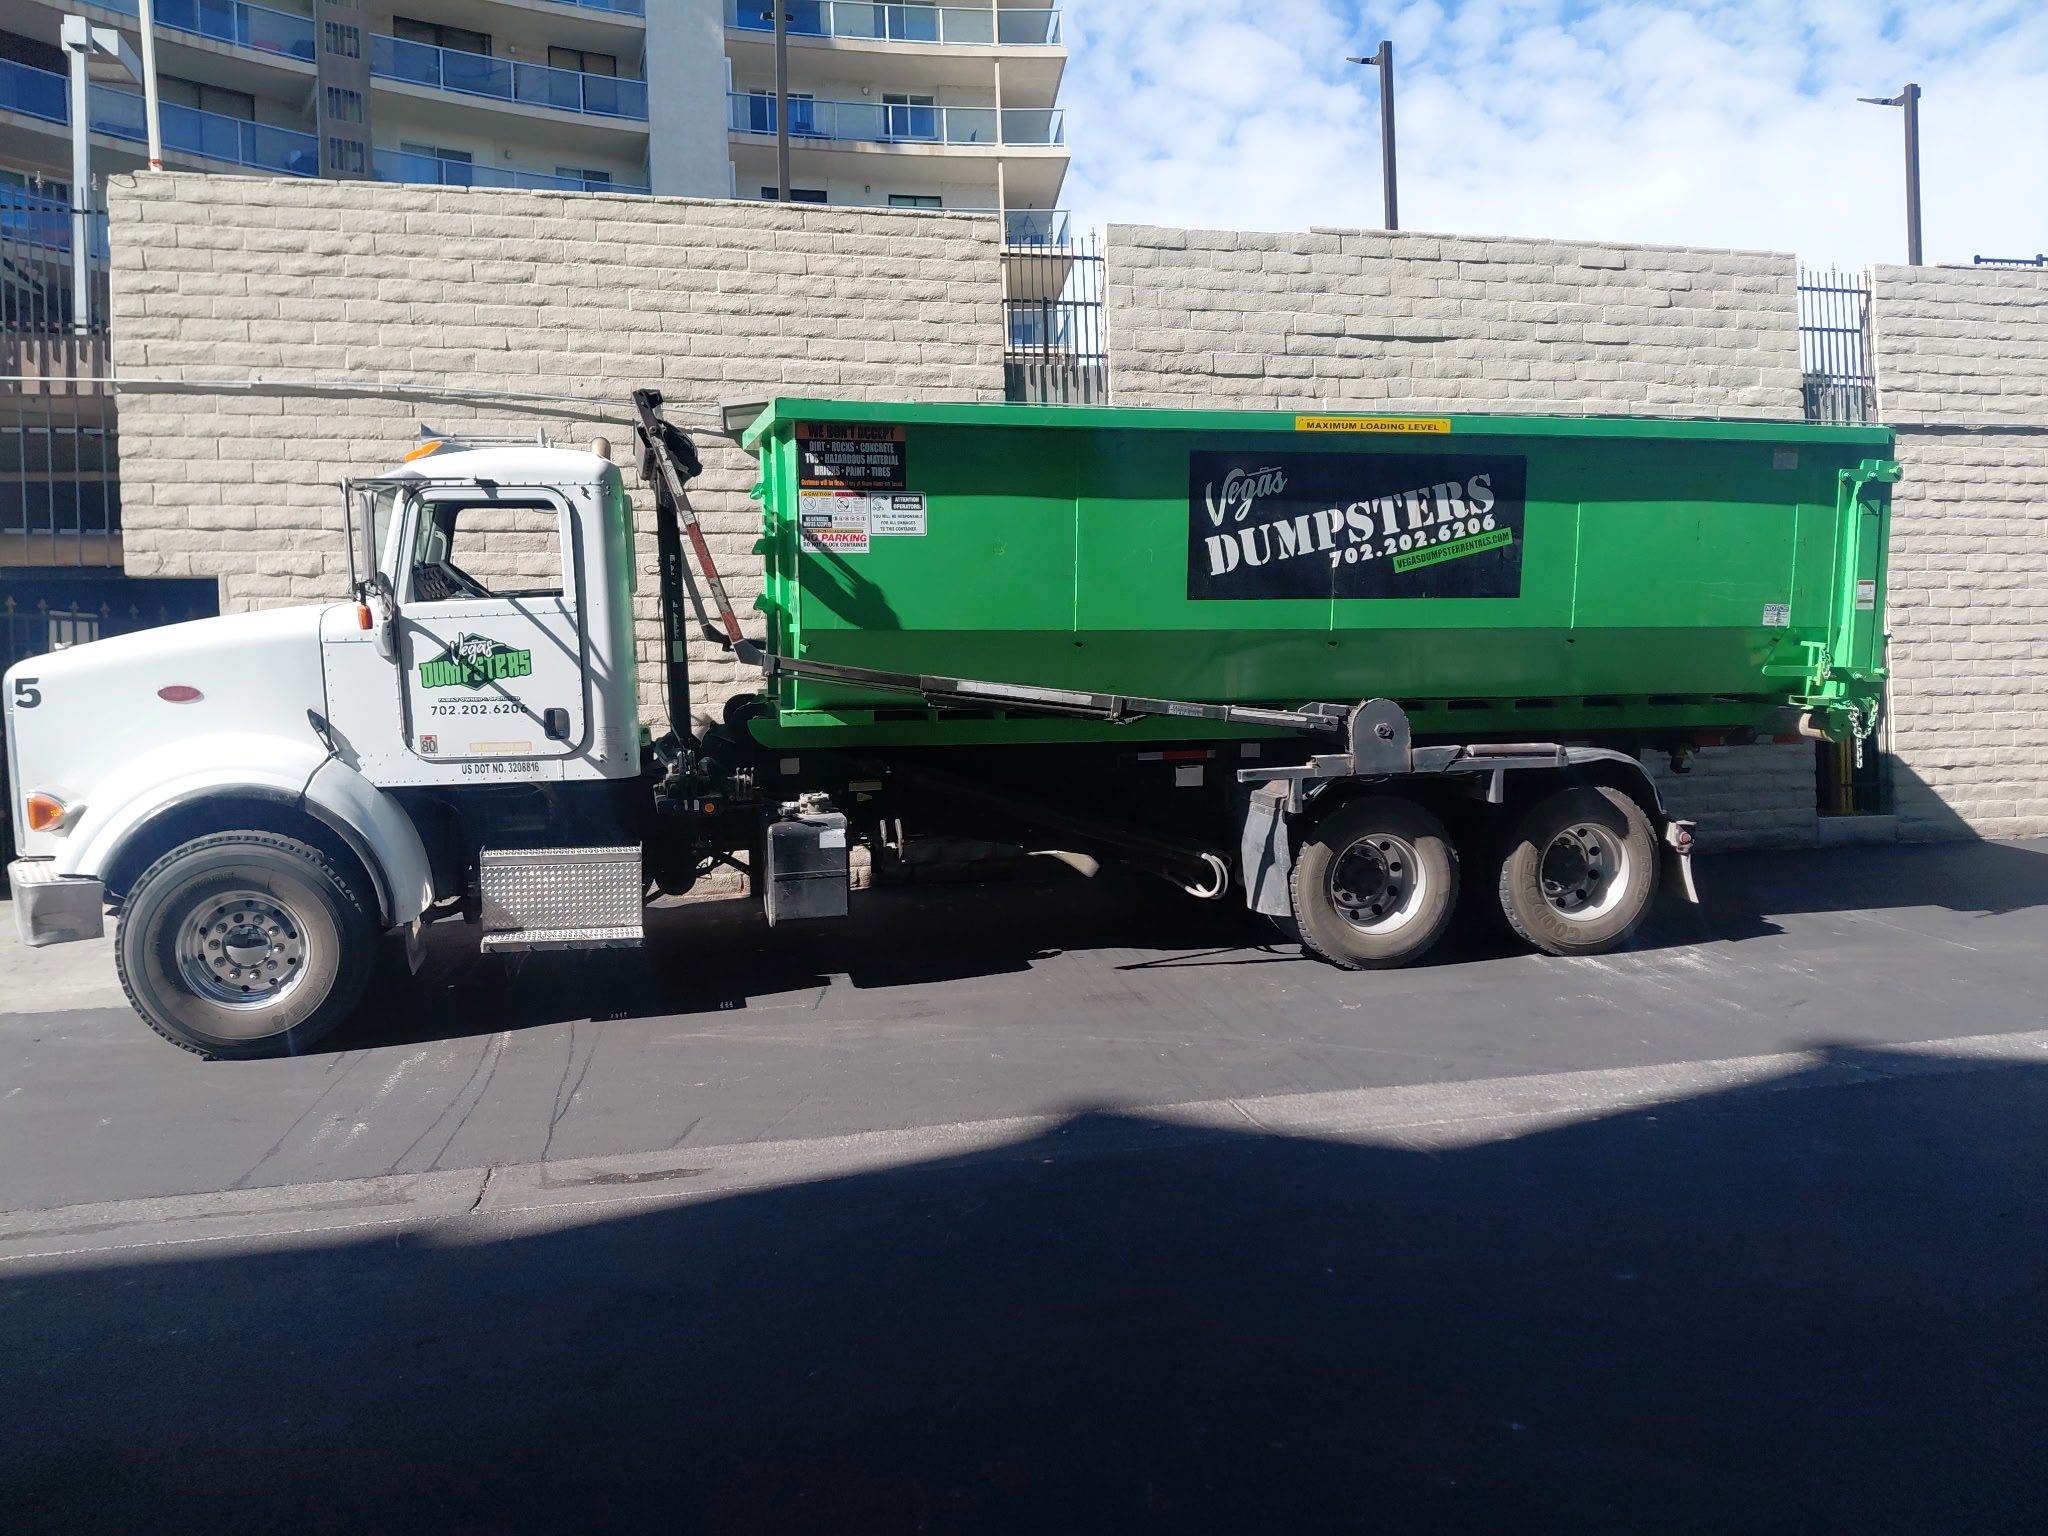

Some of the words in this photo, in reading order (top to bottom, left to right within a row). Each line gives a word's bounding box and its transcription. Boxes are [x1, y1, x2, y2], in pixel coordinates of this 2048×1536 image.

[808, 424, 825, 438] WE
[858, 425, 895, 440] ACCEPT
[1306, 421, 1357, 430] MAXIMUM
[1360, 422, 1405, 430] LOADING
[1408, 423, 1440, 431] LEVEL
[809, 441, 826, 452] DIRT
[831, 441, 855, 453] ROCKS
[860, 442, 895, 453] CONCRETE
[824, 453, 866, 465] HAZARDOUS
[866, 454, 900, 466] MATERIAL
[814, 465, 841, 476] BRICKS
[845, 466, 866, 477] PAINT
[871, 467, 891, 477] TIRES
[1205, 467, 1288, 527] Vegas
[1204, 473, 1496, 576] DUMPSTERS
[803, 533, 819, 542] NO
[821, 533, 867, 542] PARKING
[1329, 513, 1496, 569] 702.202.6206
[1396, 532, 1510, 569] VEGASDUMPSTERRENTALS.COM
[450, 632, 506, 665] Vegas
[419, 649, 532, 688] DUMPSTERS
[15, 677, 42, 709] 5
[430, 703, 528, 716] 702.202.6206
[421, 740, 436, 752] 80
[461, 764, 473, 775] US
[475, 763, 490, 774] DOT
[492, 763, 507, 774] NO.
[508, 762, 540, 773] 3208816
